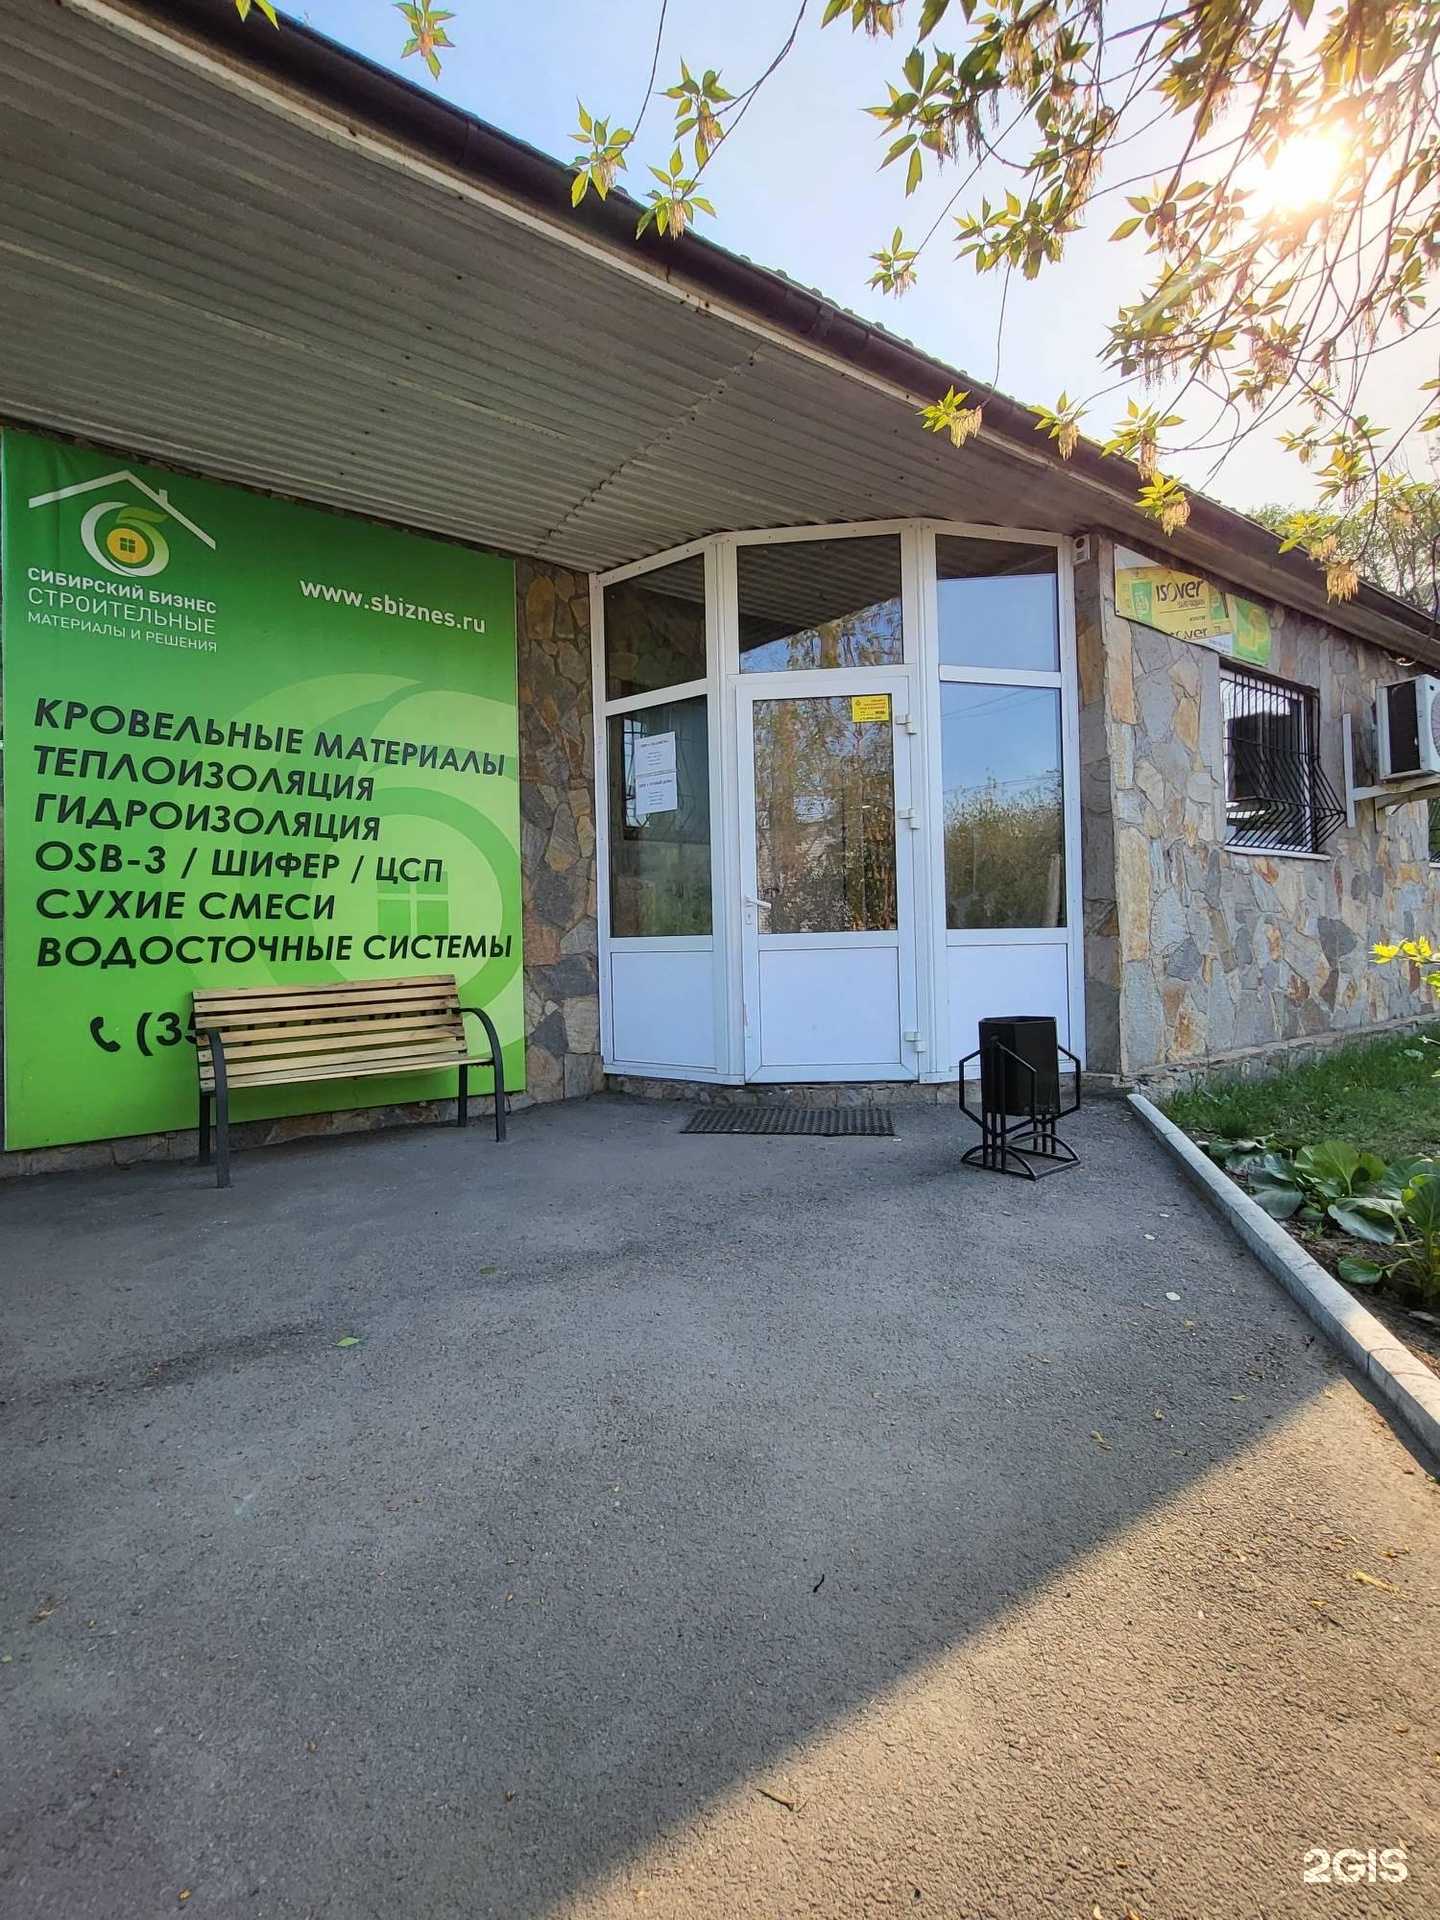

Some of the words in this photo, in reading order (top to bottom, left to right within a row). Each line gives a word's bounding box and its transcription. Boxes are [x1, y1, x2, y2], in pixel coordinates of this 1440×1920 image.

[28, 567, 144, 600] СИБИРСКИЙ
[149, 590, 217, 614] БИЗНЕС
[28, 587, 216, 635] СТРОИТЕЛЬНЫЕ
[300, 580, 486, 634] www.sbiznes.ru
[28, 611, 126, 638] МАТЕРИАЛЫ
[131, 629, 141, 641] И
[146, 632, 217, 652] РЕШЕНИЯ
[34, 698, 304, 755] КРОВЕЛЬНЫЕ
[313, 732, 505, 776] МАТЕРИАЛЫ
[33, 745, 374, 802] ТЕПЛОИЗОЛЯЦИЯ
[35, 793, 380, 842] ГИДРОИЗОЛЯЦИЯ
[35, 841, 166, 874] OSB-3
[180, 847, 198, 879] /
[212, 849, 340, 880] ШИФЕР
[350, 855, 365, 884] /
[376, 856, 443, 885] ЦСП
[36, 888, 186, 920] СУХИЕ
[199, 892, 335, 920] СМЕСИ
[37, 935, 353, 970] ВОДОСТОЧНЫЕ
[363, 934, 512, 961] СИСТЕМЫ
